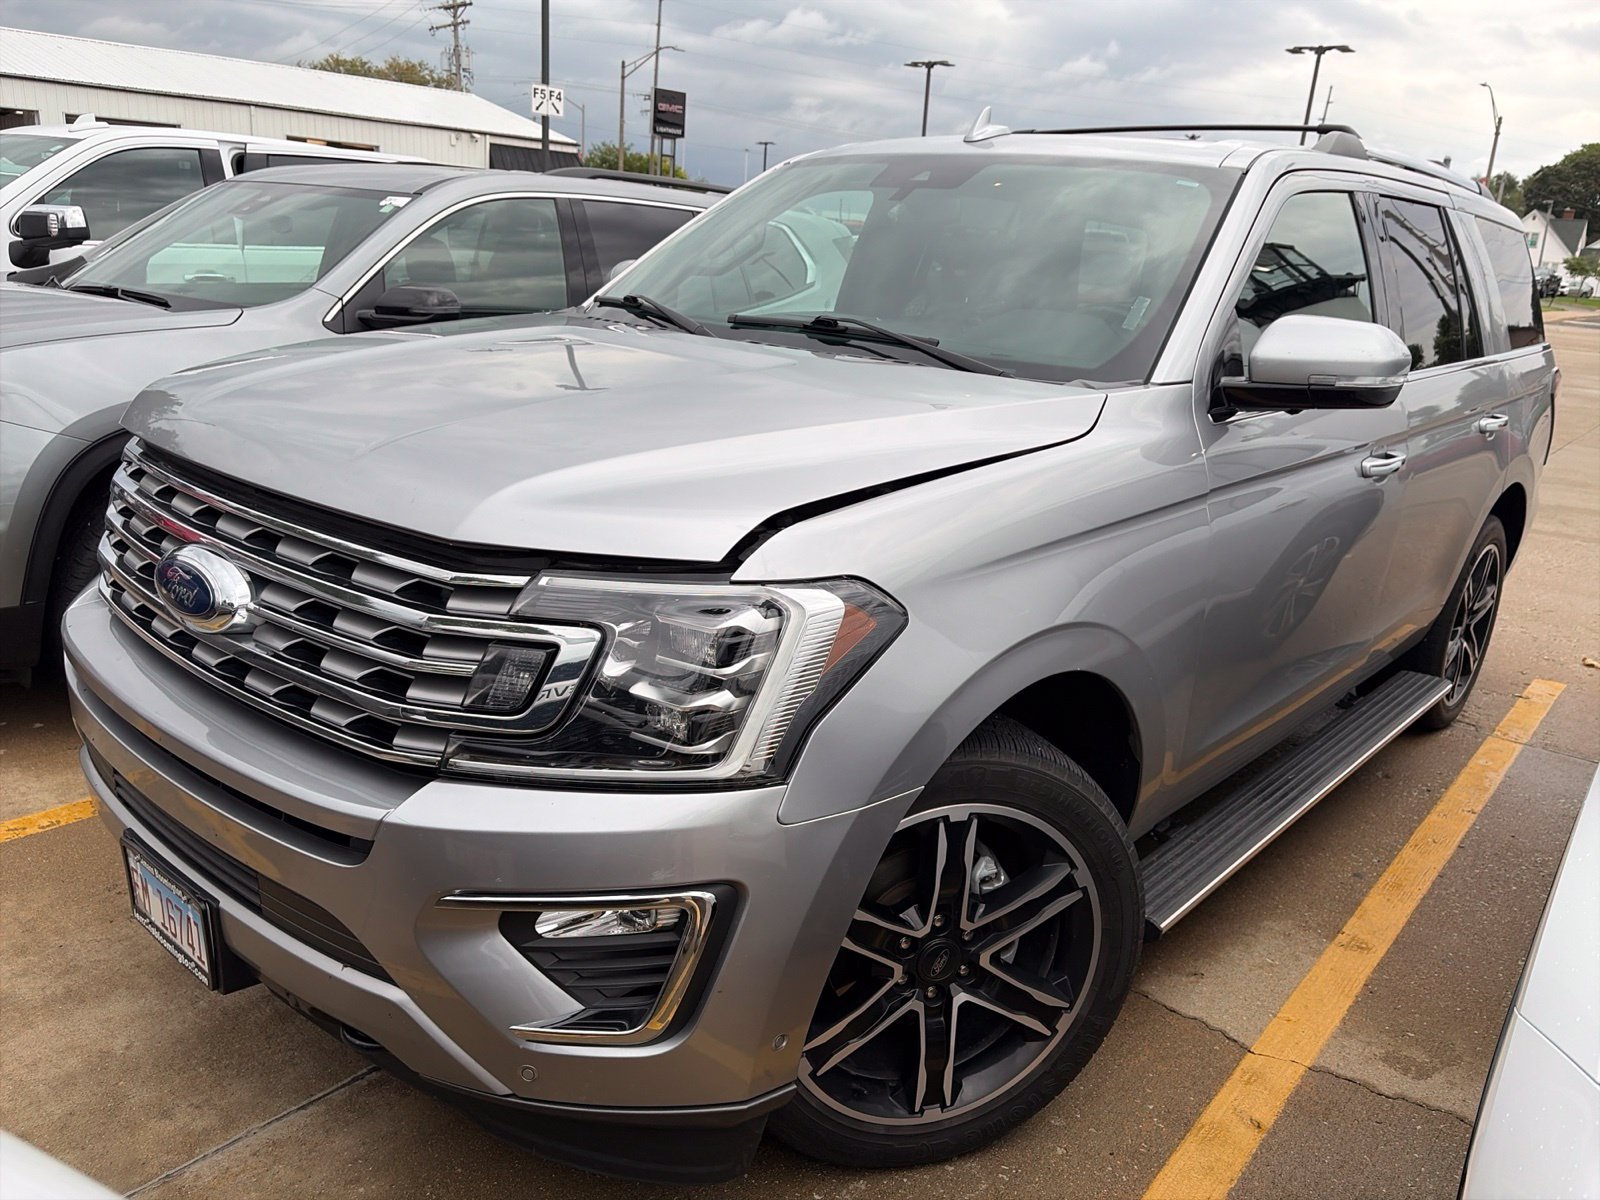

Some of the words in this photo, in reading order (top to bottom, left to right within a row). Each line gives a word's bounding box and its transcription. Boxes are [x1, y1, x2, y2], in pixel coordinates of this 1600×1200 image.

[533, 87, 546, 100] F5
[549, 90, 562, 102] F4
[657, 102, 684, 113] GMC
[163, 566, 199, 607] Ford
[156, 888, 205, 966] 16741
